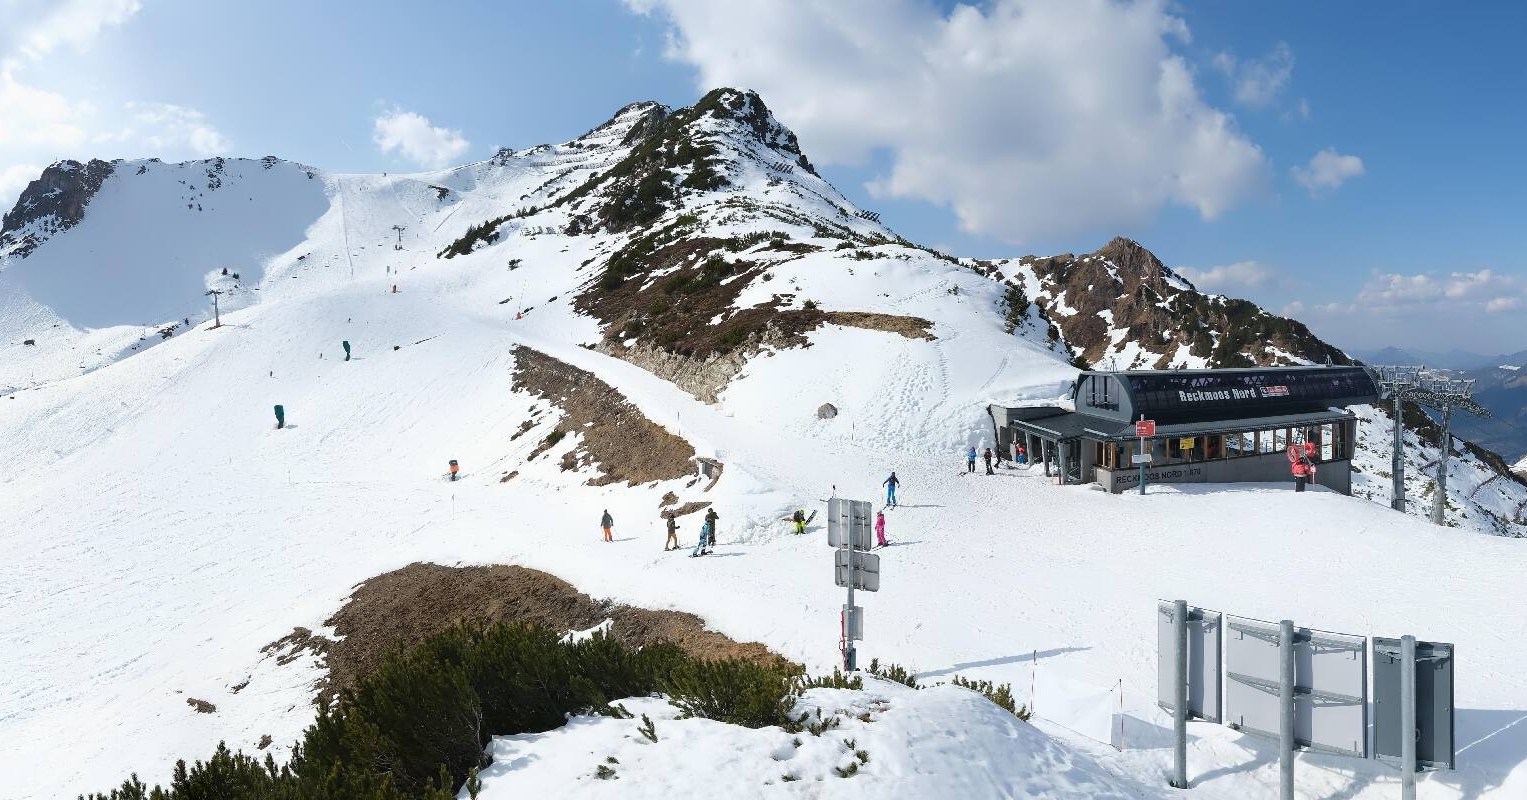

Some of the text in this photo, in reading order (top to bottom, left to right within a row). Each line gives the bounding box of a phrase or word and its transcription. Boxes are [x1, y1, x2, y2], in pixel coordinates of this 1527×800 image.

[1178, 389, 1230, 402] Reckmoos
[1232, 387, 1256, 400] Nord
[1116, 472, 1159, 484] RECKOOS
[1161, 470, 1182, 480] NORD
